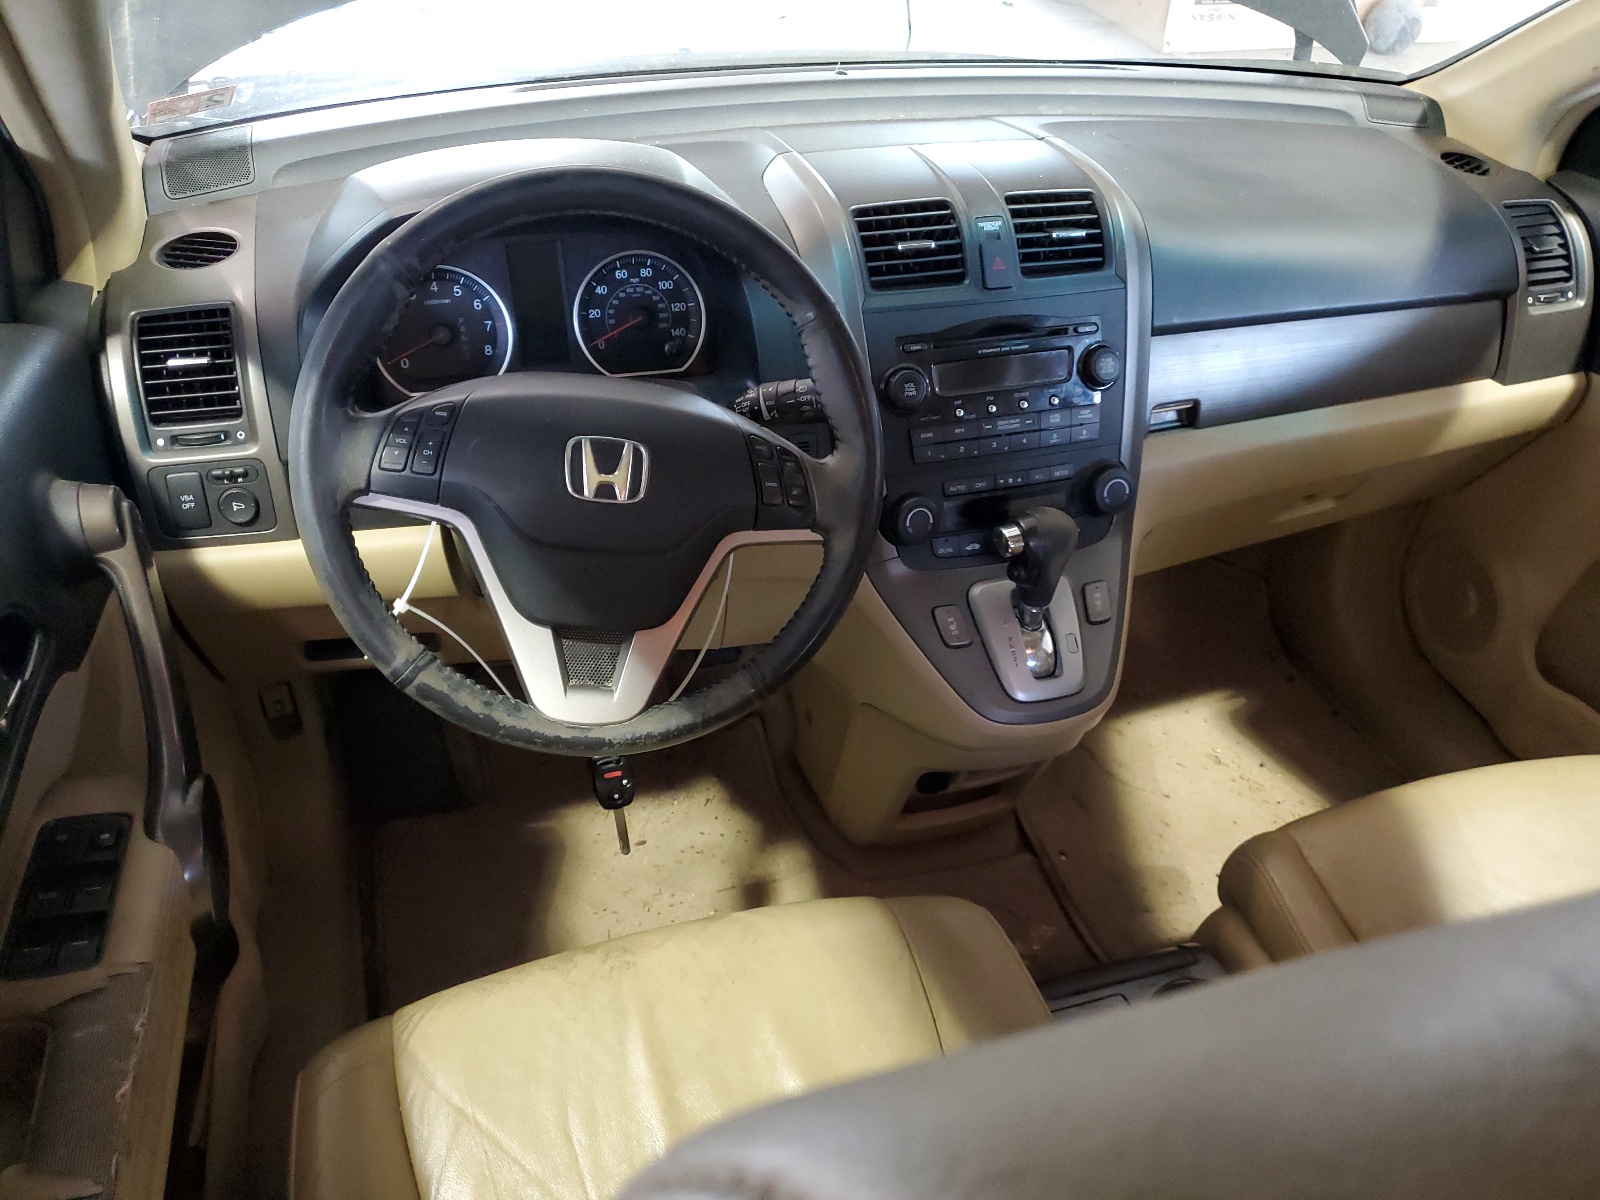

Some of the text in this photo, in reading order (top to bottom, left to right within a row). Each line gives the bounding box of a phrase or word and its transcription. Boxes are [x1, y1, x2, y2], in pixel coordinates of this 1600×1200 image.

[615, 269, 628, 279] 60
[640, 267, 652, 277] 80
[430, 281, 438, 292] 4
[595, 285, 607, 295] 40
[658, 280, 673, 290] 100
[453, 285, 462, 297] 5
[473, 299, 482, 310] 6
[671, 302, 686, 312] 120
[588, 308, 601, 319] 20
[484, 321, 492, 332] 7
[670, 327, 686, 337] 140
[484, 344, 493, 355] 8
[598, 340, 605, 349] 0
[400, 358, 409, 369] 0
[741, 400, 751, 408] OFF
[949, 484, 966, 492] AUTO
